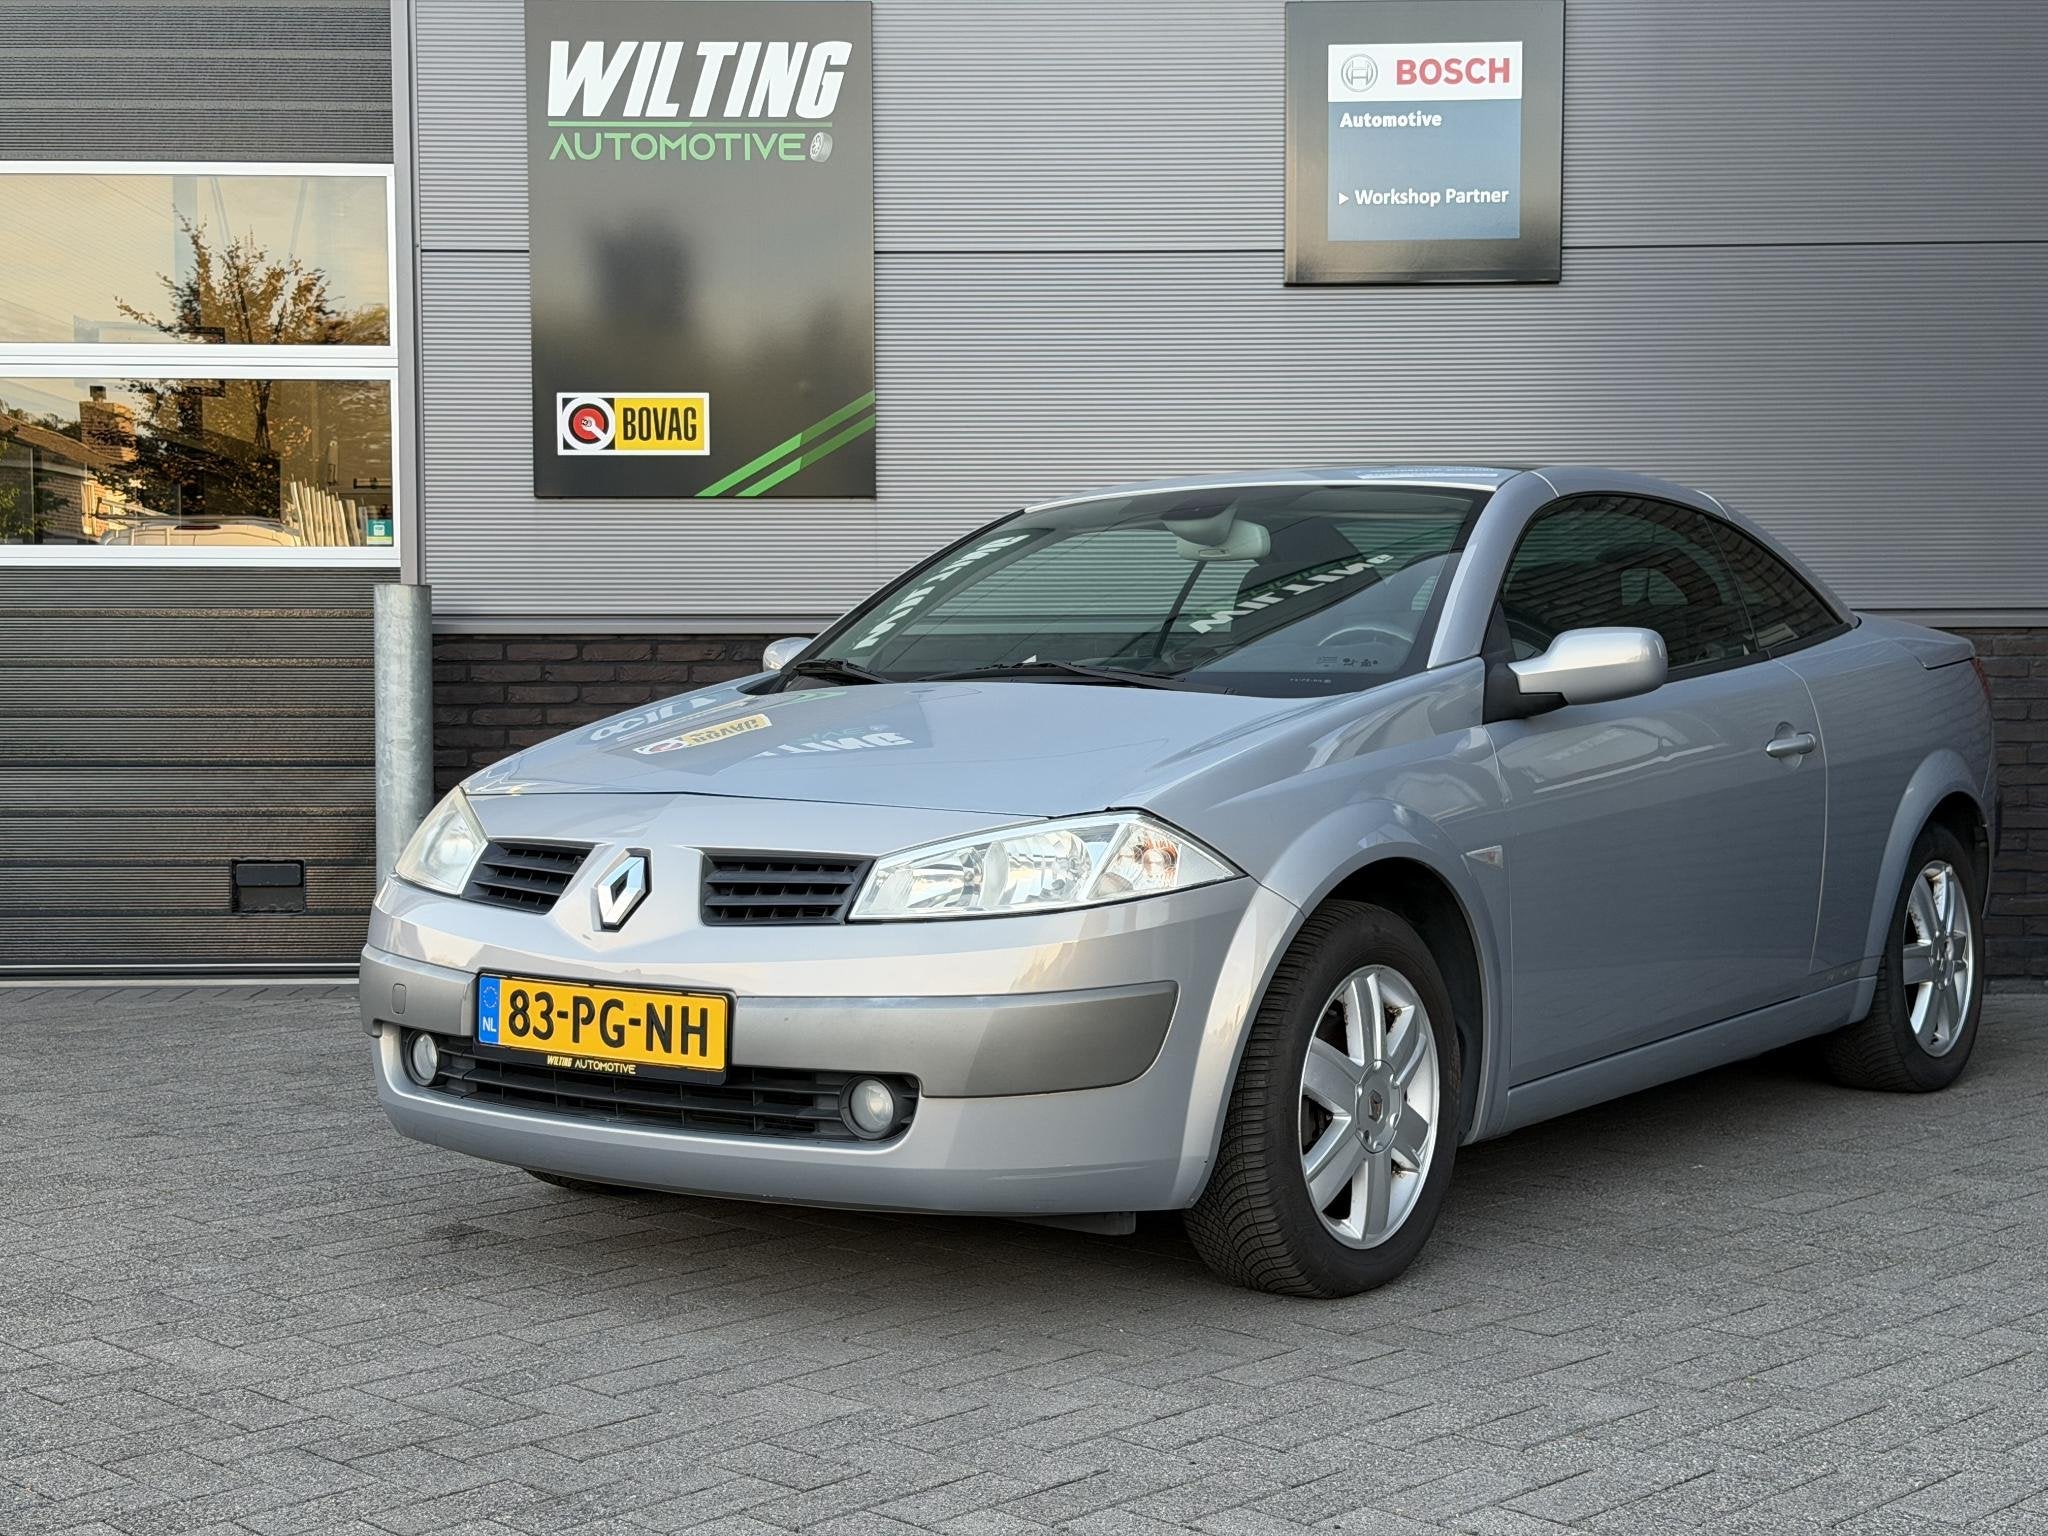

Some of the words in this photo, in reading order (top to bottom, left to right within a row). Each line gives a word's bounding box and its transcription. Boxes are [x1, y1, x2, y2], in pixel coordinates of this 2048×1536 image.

[547, 40, 853, 119] WILTING
[1396, 58, 1511, 86] BOSCH
[1339, 111, 1443, 128] Automotive
[549, 132, 806, 161] AUTOMOTIVE
[1354, 188, 1441, 207] Workshop
[1445, 188, 1510, 204] Partner
[622, 407, 698, 442] BOVAG
[482, 1016, 497, 1032] NL
[508, 989, 708, 1057] 83-PG-NH
[547, 1055, 573, 1067] WILTING
[574, 1059, 637, 1074] AUTOMOTIVE
